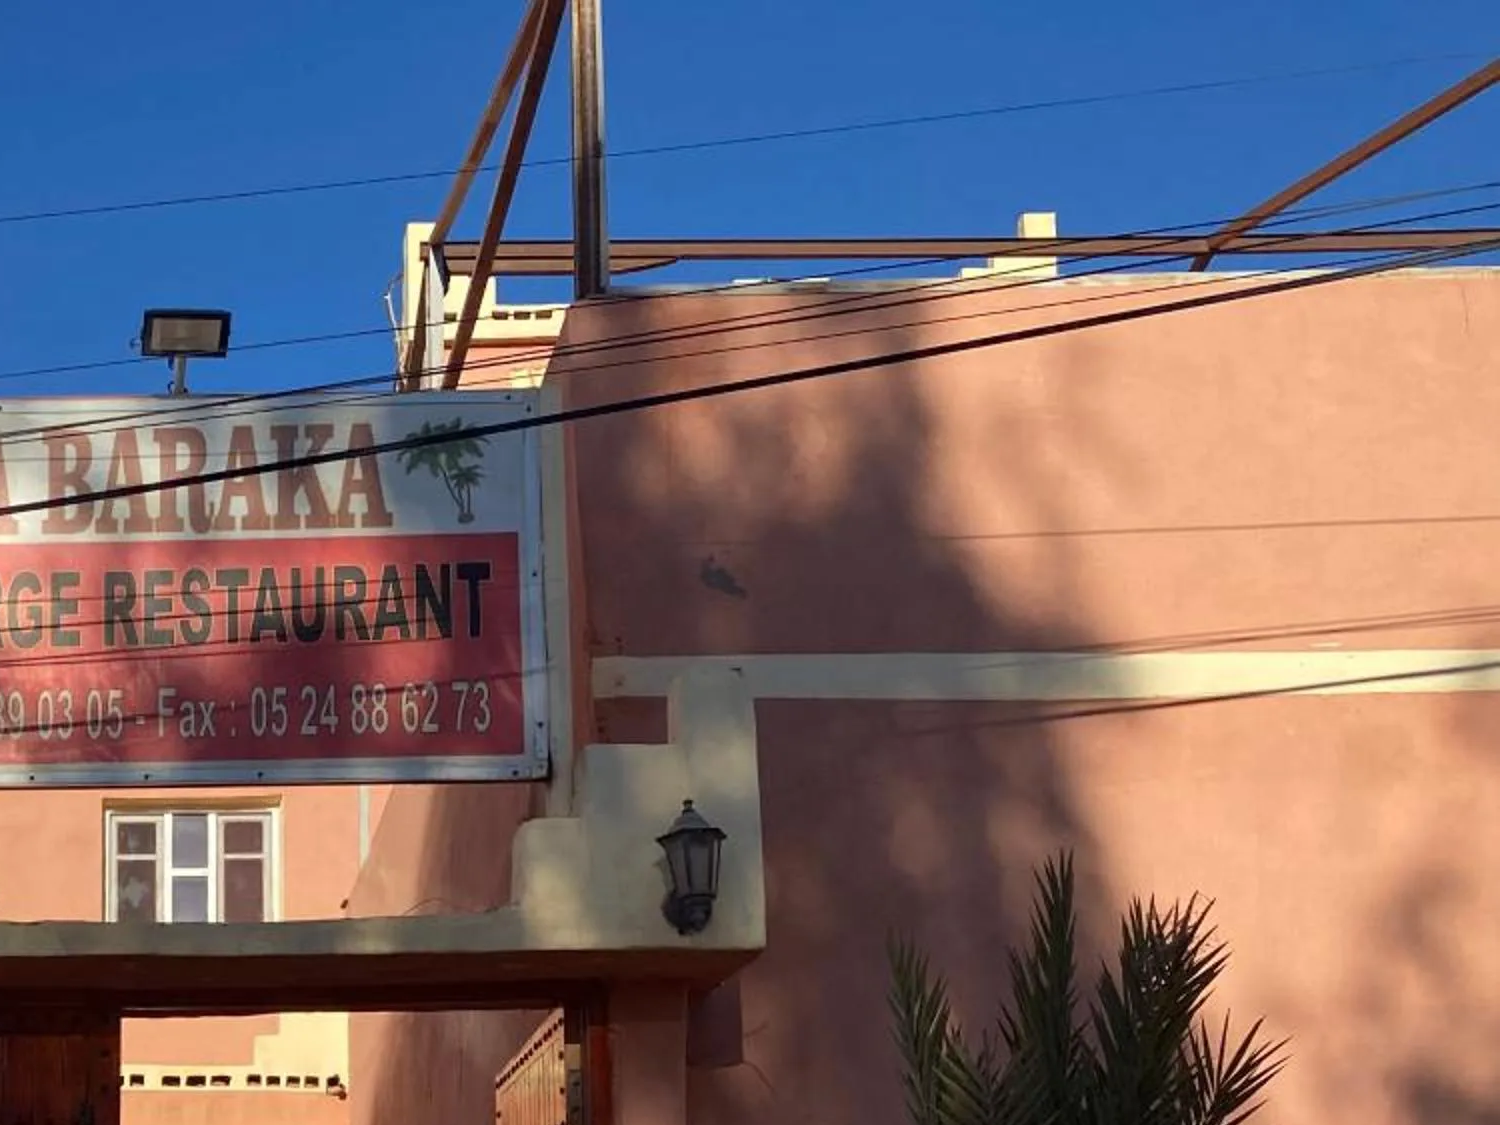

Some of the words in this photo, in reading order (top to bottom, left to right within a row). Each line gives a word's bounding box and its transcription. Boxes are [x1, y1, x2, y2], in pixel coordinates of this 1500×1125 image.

[41, 423, 393, 534] BARAKA
[103, 562, 492, 647] RESTAURANT
[37, 690, 74, 739] 03
[86, 688, 124, 738] 05
[157, 687, 217, 738] Fax
[250, 686, 288, 737] 05
[300, 685, 339, 736] 24
[351, 683, 389, 735] 88
[401, 682, 440, 734] 62
[451, 681, 492, 733] 73
